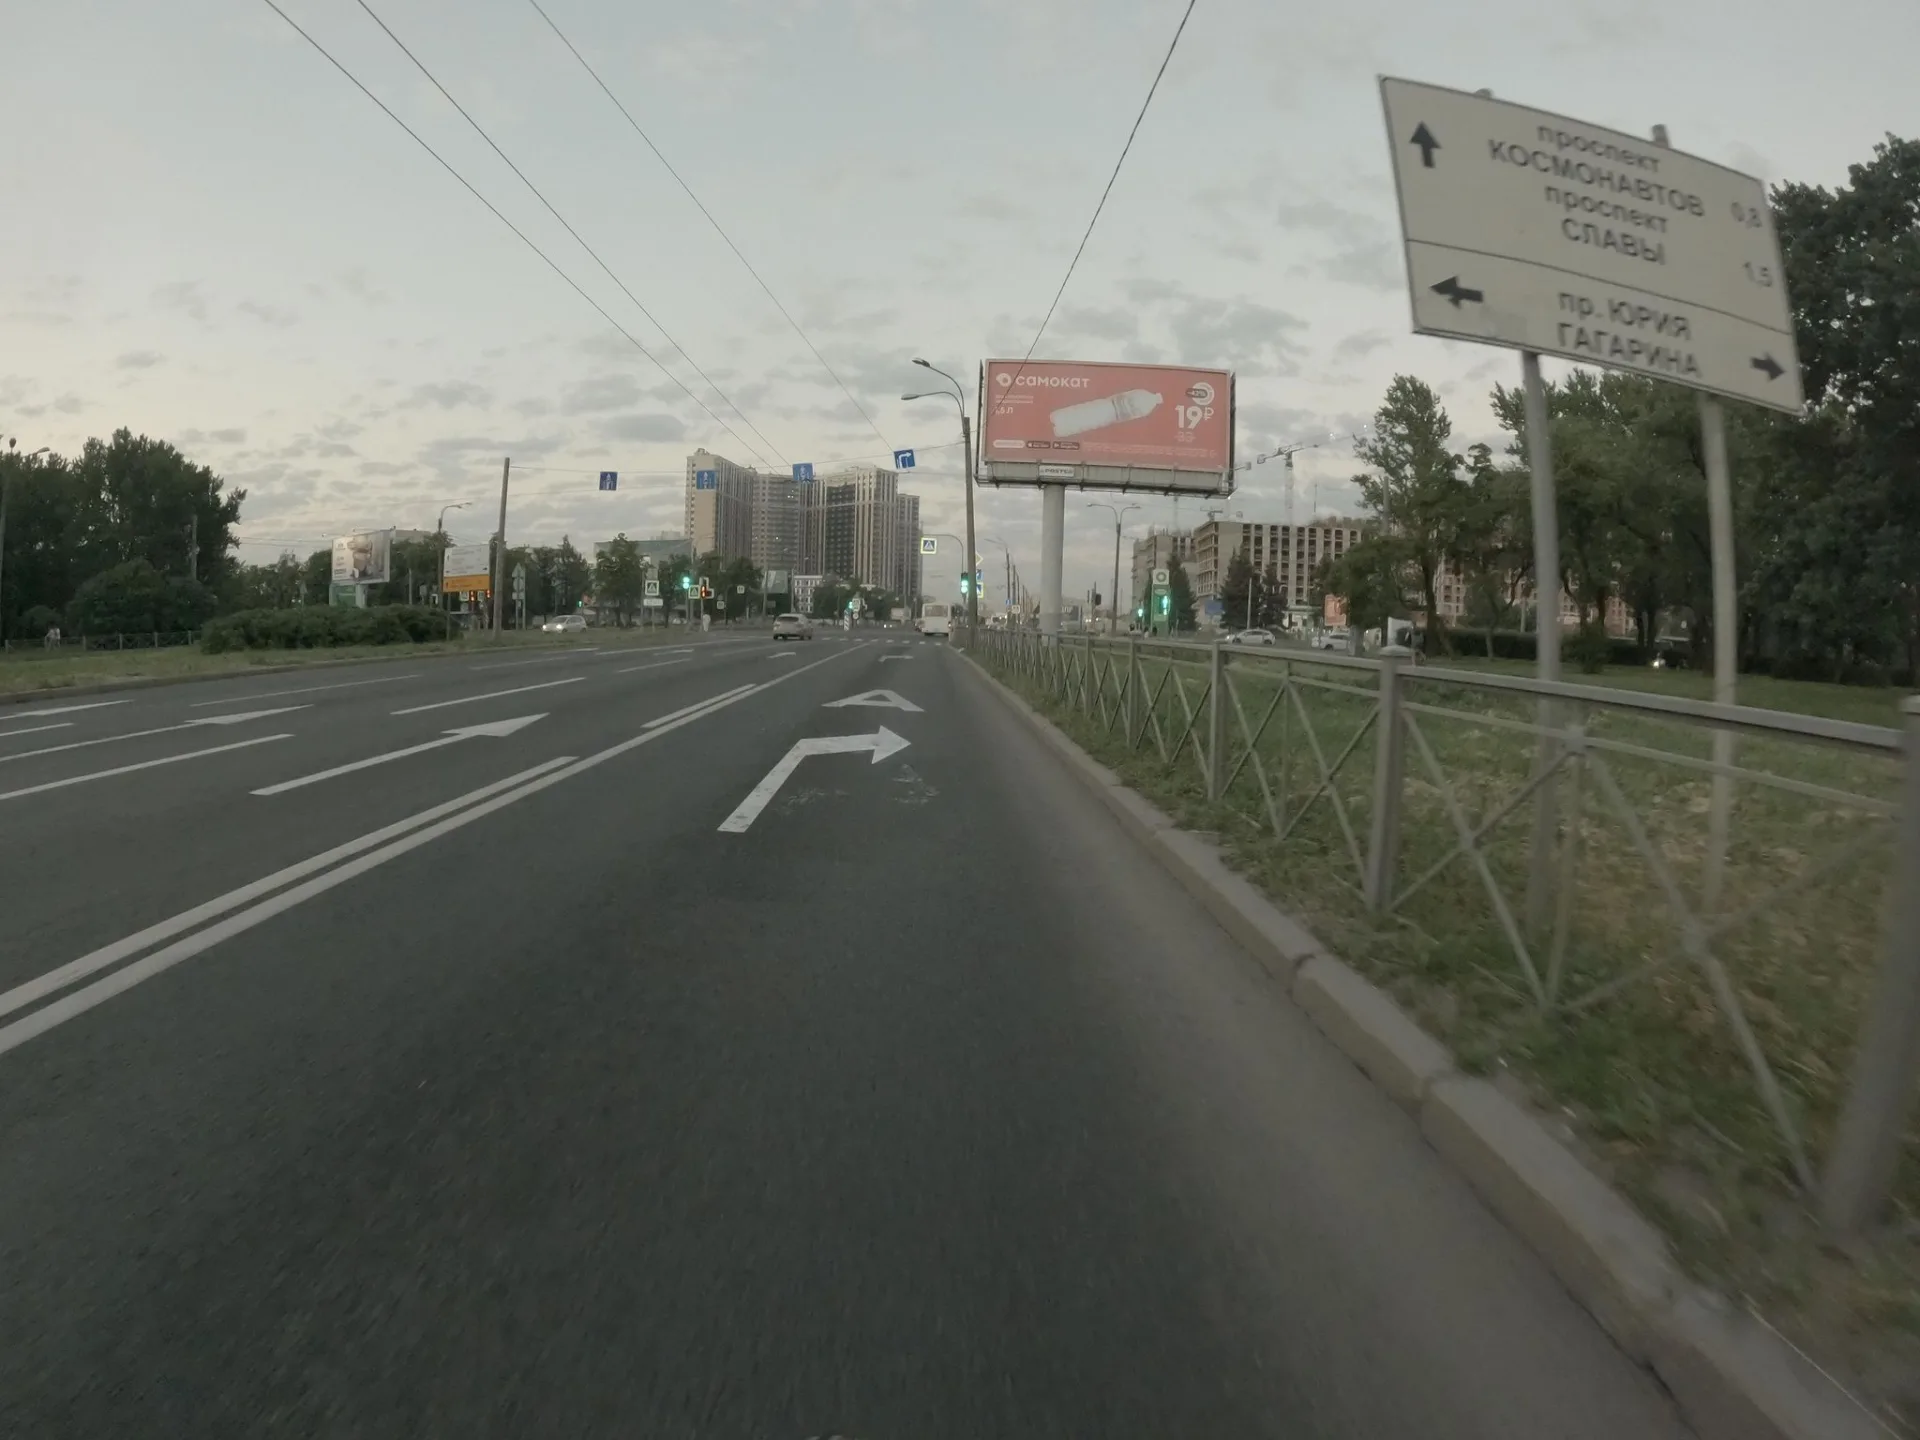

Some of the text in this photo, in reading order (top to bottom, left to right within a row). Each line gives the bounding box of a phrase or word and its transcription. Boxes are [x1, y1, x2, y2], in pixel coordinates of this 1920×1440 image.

[1536, 125, 1660, 173] проспект
[1488, 138, 1705, 217] КОСМОНАВТОВ
[1544, 185, 1668, 234] проспект
[1561, 217, 1667, 266] СЛАВЫ
[1608, 298, 1692, 341] ЮРИЯ
[1557, 321, 1703, 378] ГАГАРИНА
